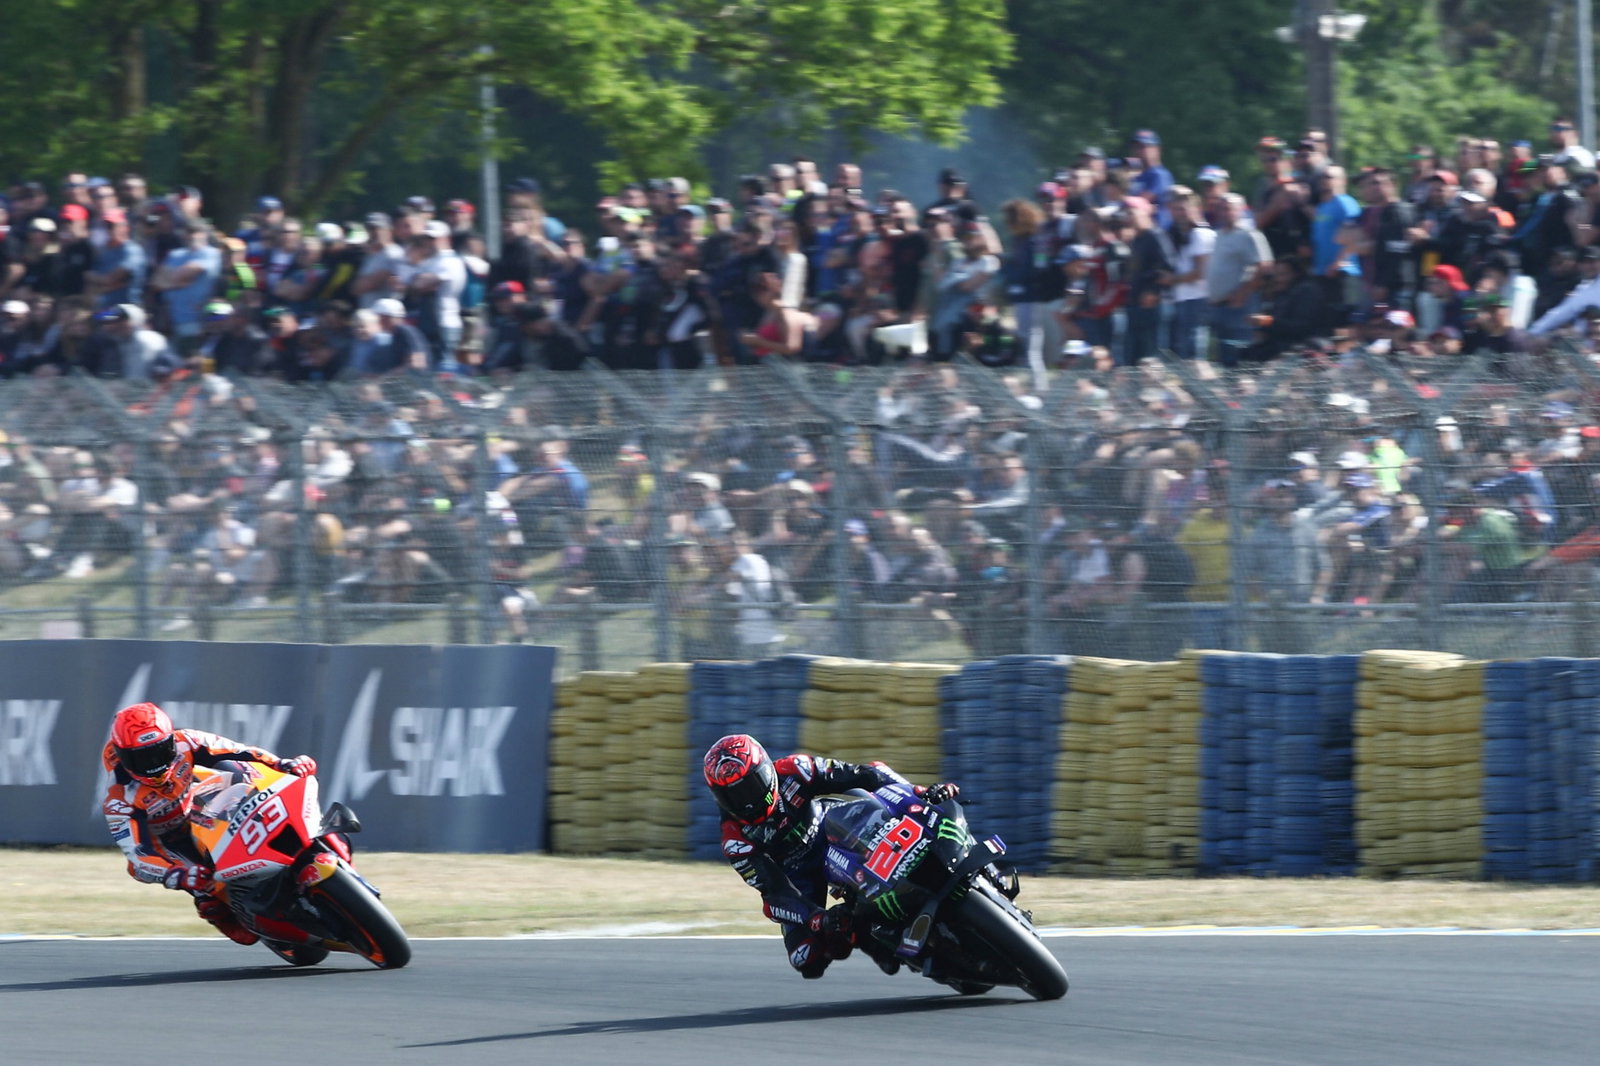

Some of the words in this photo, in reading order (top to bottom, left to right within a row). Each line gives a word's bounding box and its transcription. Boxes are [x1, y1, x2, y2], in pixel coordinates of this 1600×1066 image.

[388, 706, 518, 797] SHARK
[227, 788, 276, 837] REPSOL
[240, 794, 289, 855] 93
[867, 817, 901, 852] ENEOS
[221, 861, 268, 879] HONDA
[826, 846, 850, 871] YAMAHA
[863, 815, 924, 882] 20
[892, 837, 932, 881] MONSTER
[769, 905, 804, 925] YAMAHA
